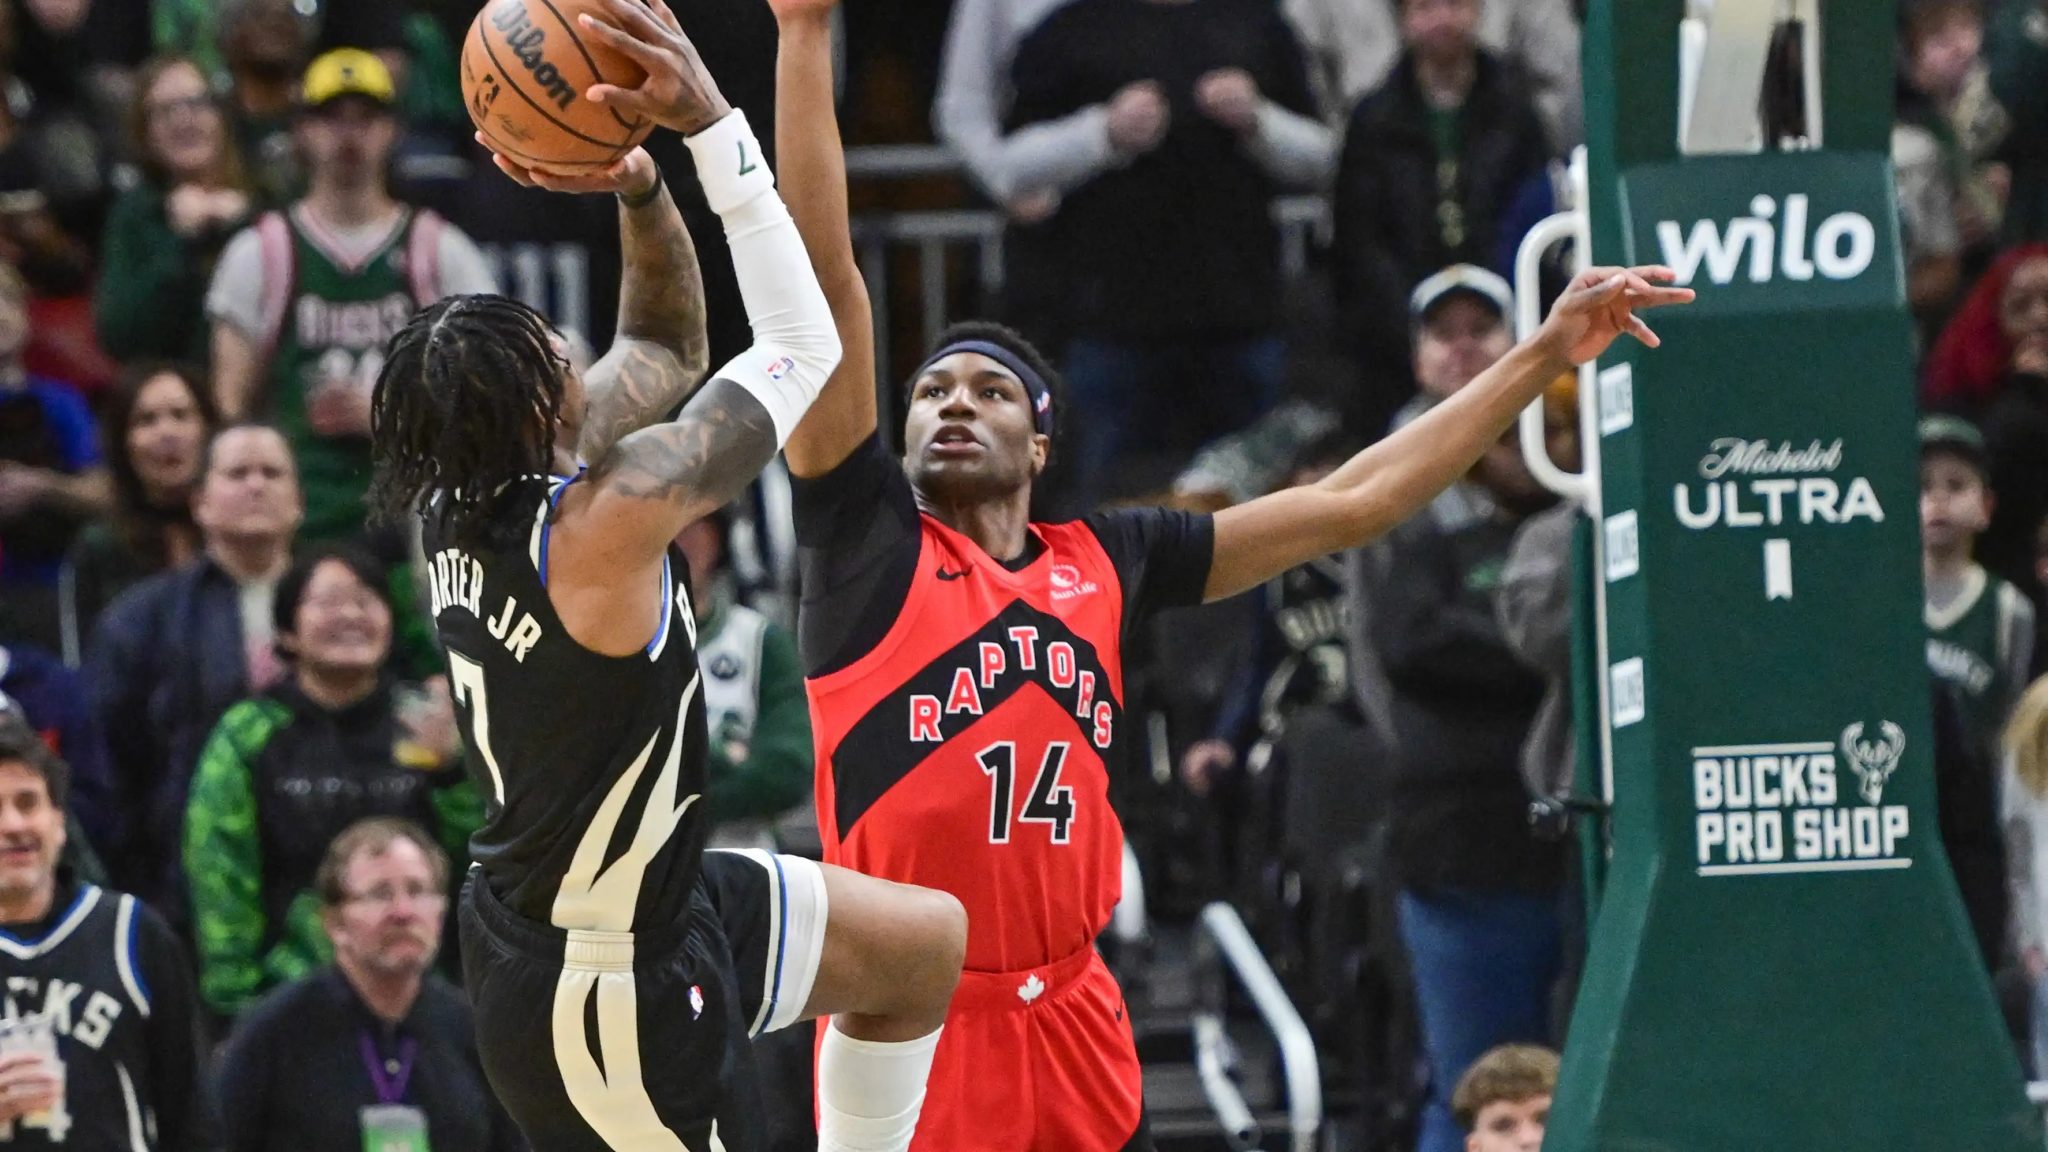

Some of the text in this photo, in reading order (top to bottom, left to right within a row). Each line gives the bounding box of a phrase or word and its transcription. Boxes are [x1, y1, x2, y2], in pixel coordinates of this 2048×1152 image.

[492, 0, 576, 112] Wilson
[1656, 193, 1876, 286] wilo
[1674, 477, 1885, 530] ULTRA
[487, 595, 542, 663] JR
[447, 646, 505, 806] 7
[910, 626, 1113, 749] RAPTORS
[975, 740, 1076, 844] 14
[1693, 754, 1838, 811] BUCKS
[1696, 805, 1910, 864] PRO SHOP
